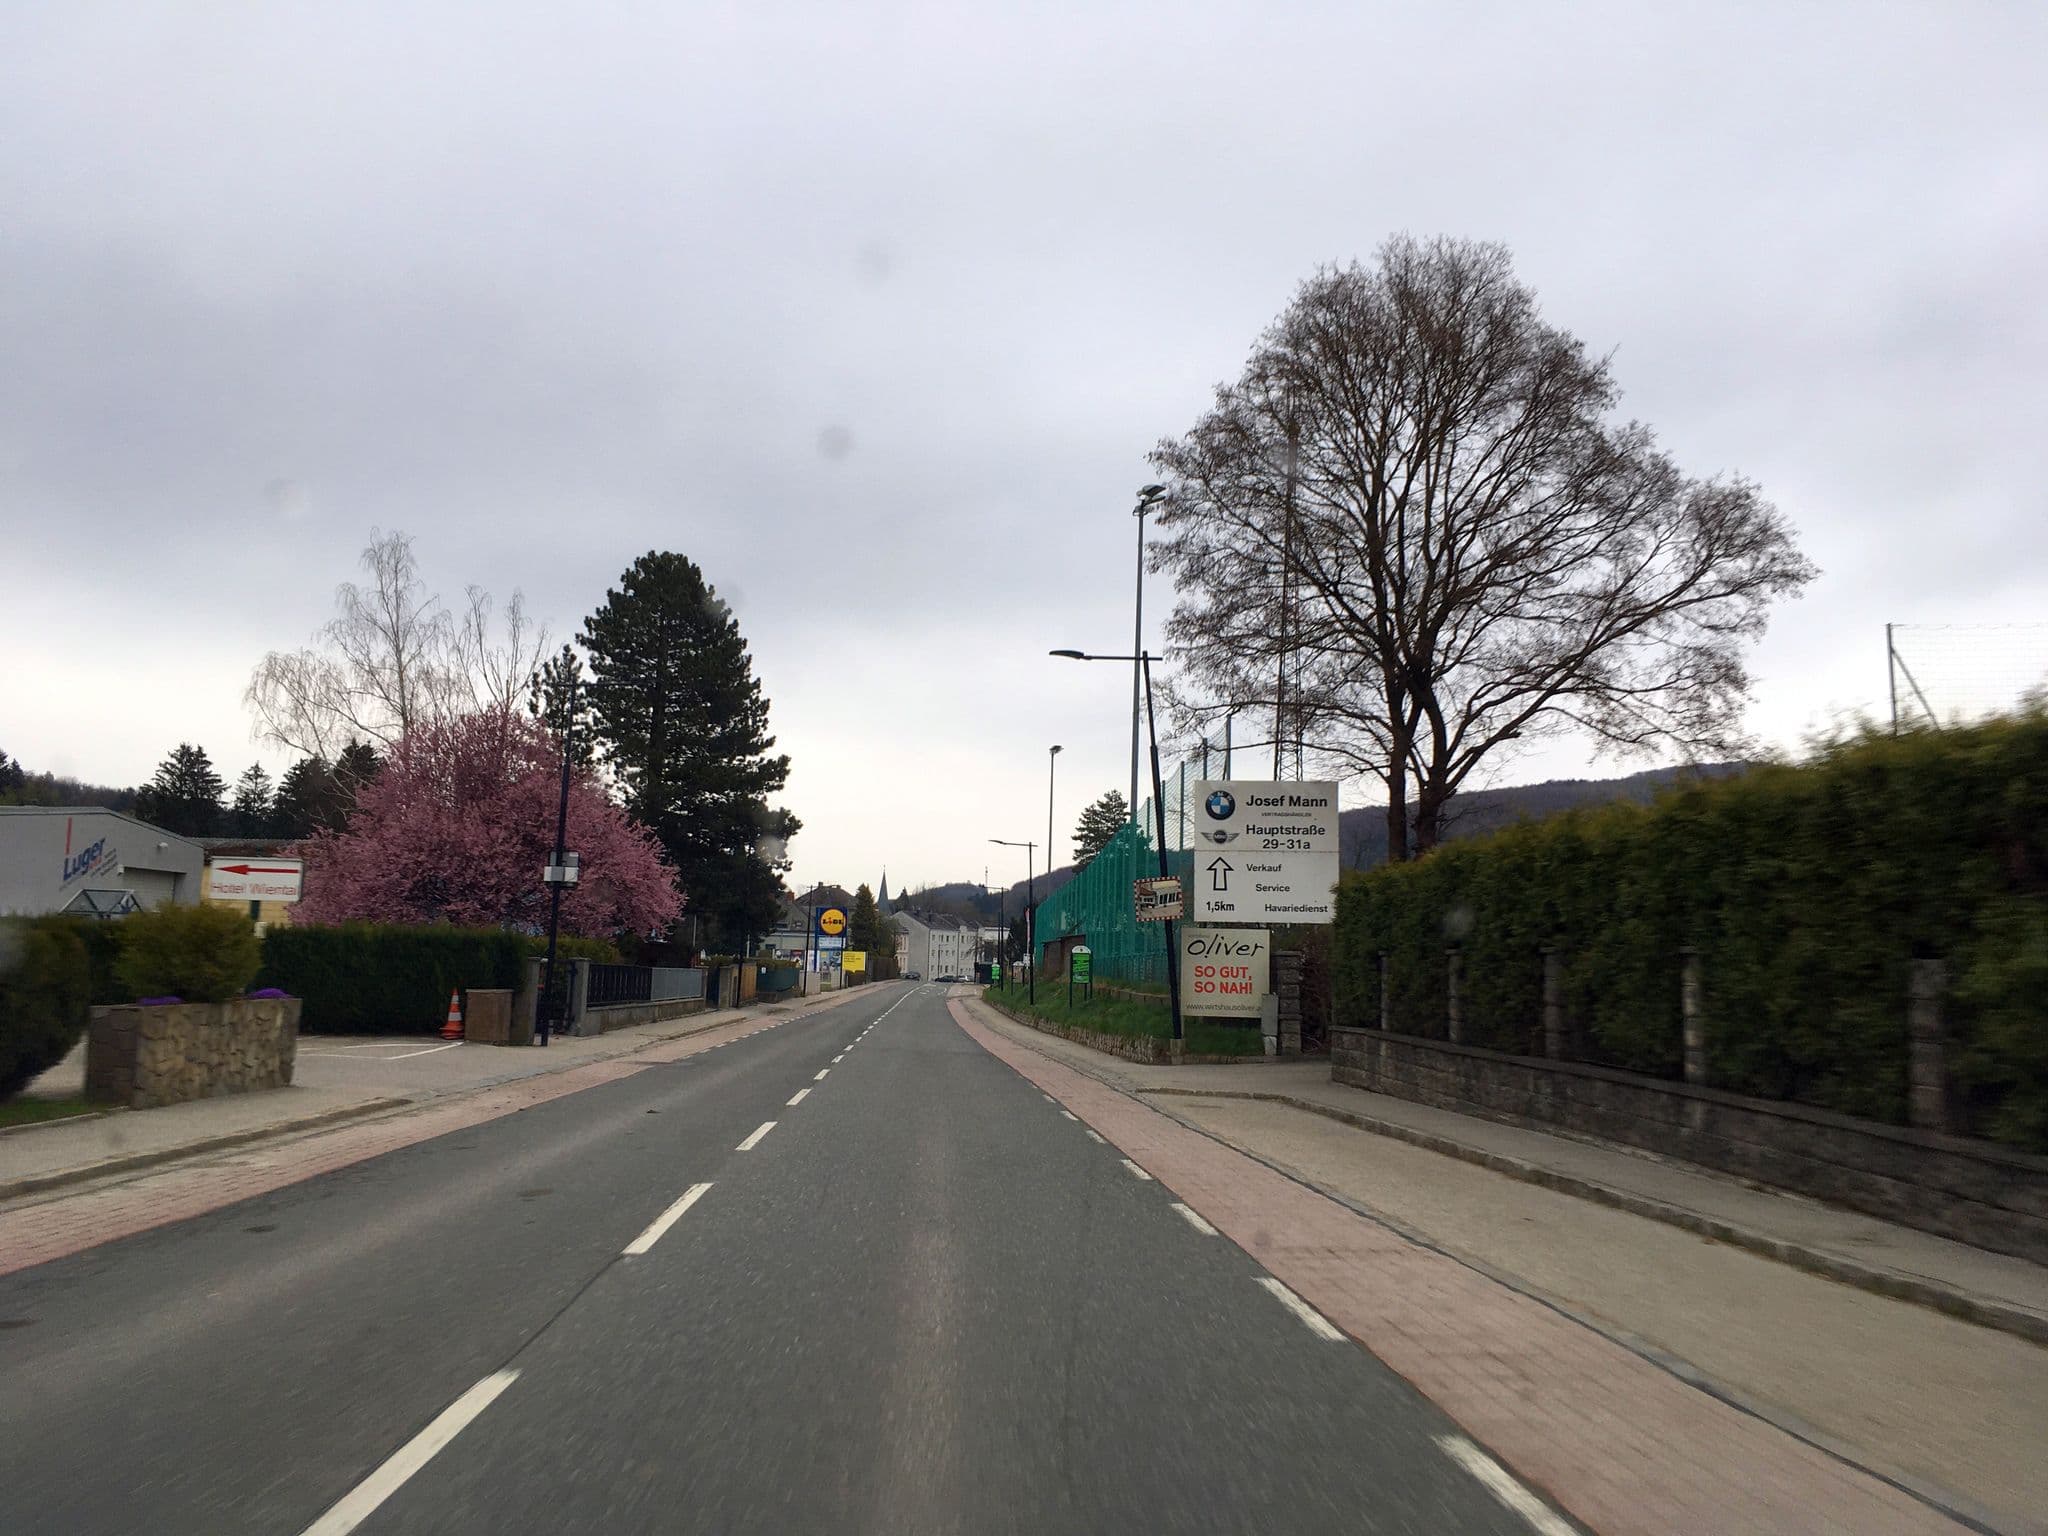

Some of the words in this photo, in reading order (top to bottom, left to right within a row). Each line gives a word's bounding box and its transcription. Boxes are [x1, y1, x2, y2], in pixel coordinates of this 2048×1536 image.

[1246, 795, 1285, 807] Josef
[1289, 795, 1328, 807] Mann
[1246, 824, 1326, 837] Hauptstraße
[1262, 839, 1311, 850] 29-31a
[63, 838, 106, 881] Luger
[1246, 863, 1282, 872] Verkauf
[211, 883, 245, 894] Hotel
[1255, 883, 1291, 892] Service
[1206, 901, 1235, 913] 1,5km
[1264, 903, 1329, 913] Havariedienst
[1194, 965, 1216, 978] SO
[1219, 966, 1252, 981] GUT,
[1194, 981, 1216, 993] SO
[1219, 981, 1253, 994] NAH!
